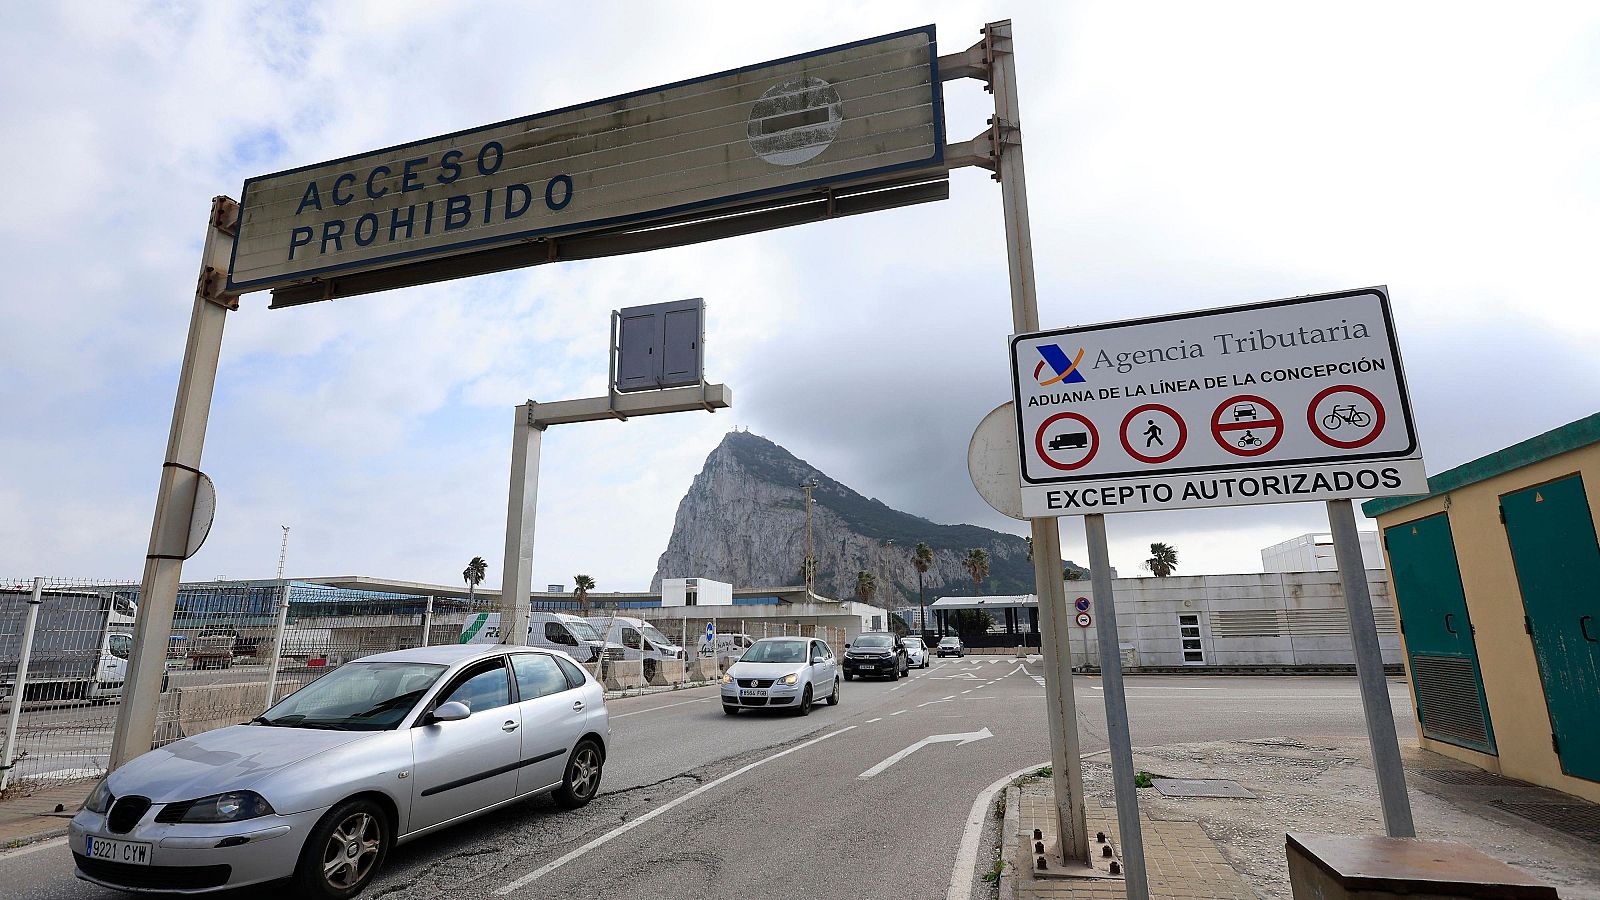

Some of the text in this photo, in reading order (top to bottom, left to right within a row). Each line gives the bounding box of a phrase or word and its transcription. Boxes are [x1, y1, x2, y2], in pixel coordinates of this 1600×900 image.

[295, 141, 504, 215] ACCESO
[287, 174, 573, 260] PROHIBIDO
[1092, 319, 1371, 374] Agencia Tributaria
[1028, 357, 1386, 407] ADUANA DE LA LÍNEA DE LA CONCEPCIÓN
[1046, 467, 1402, 510] EXCEPTO AUTORIZADOS
[93, 840, 147, 863] 9221 CYW
